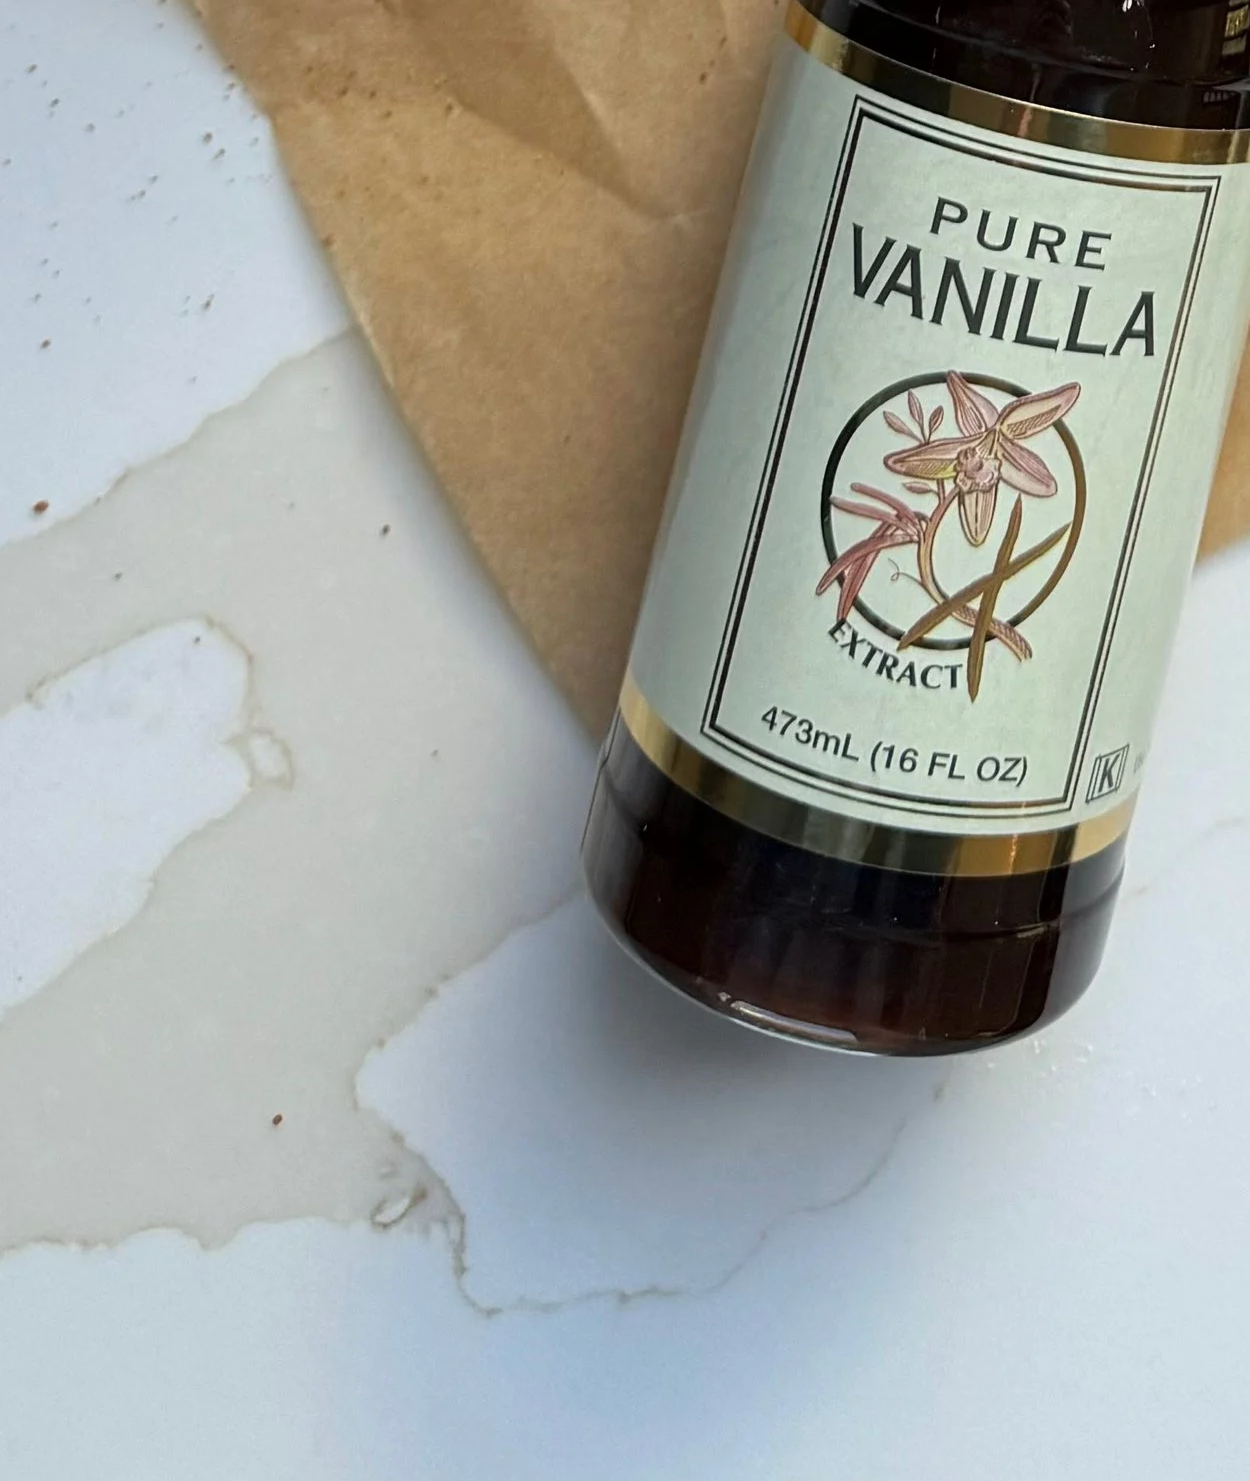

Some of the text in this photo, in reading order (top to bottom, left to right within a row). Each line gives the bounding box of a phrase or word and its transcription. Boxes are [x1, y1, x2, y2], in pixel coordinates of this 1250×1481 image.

[929, 196, 1112, 271] PURE
[852, 222, 1155, 357] VANILLA
[827, 618, 963, 689] EXTRACT
[761, 706, 1028, 787] 473mL (16 FL OZ)
[1098, 752, 1121, 793] K
